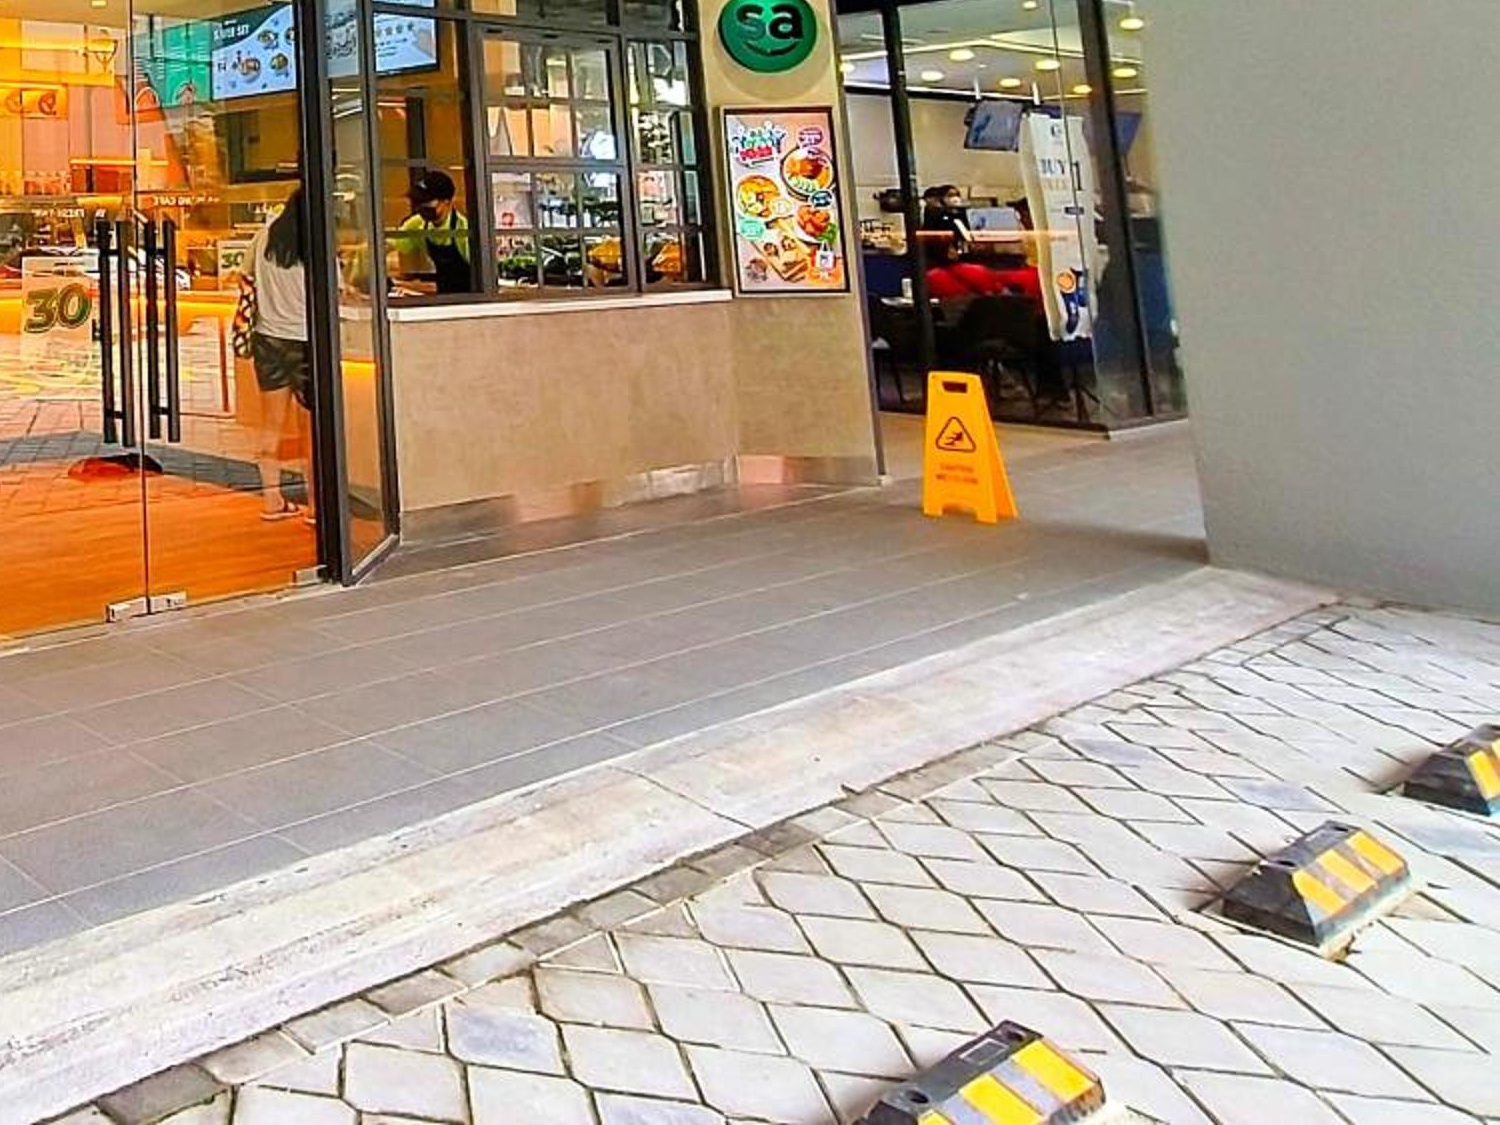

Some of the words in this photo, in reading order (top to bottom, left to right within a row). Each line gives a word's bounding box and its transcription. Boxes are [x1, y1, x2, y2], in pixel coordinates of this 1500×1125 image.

[736, 4, 804, 40] sa
[222, 251, 245, 269] 30
[24, 282, 93, 334] 30
